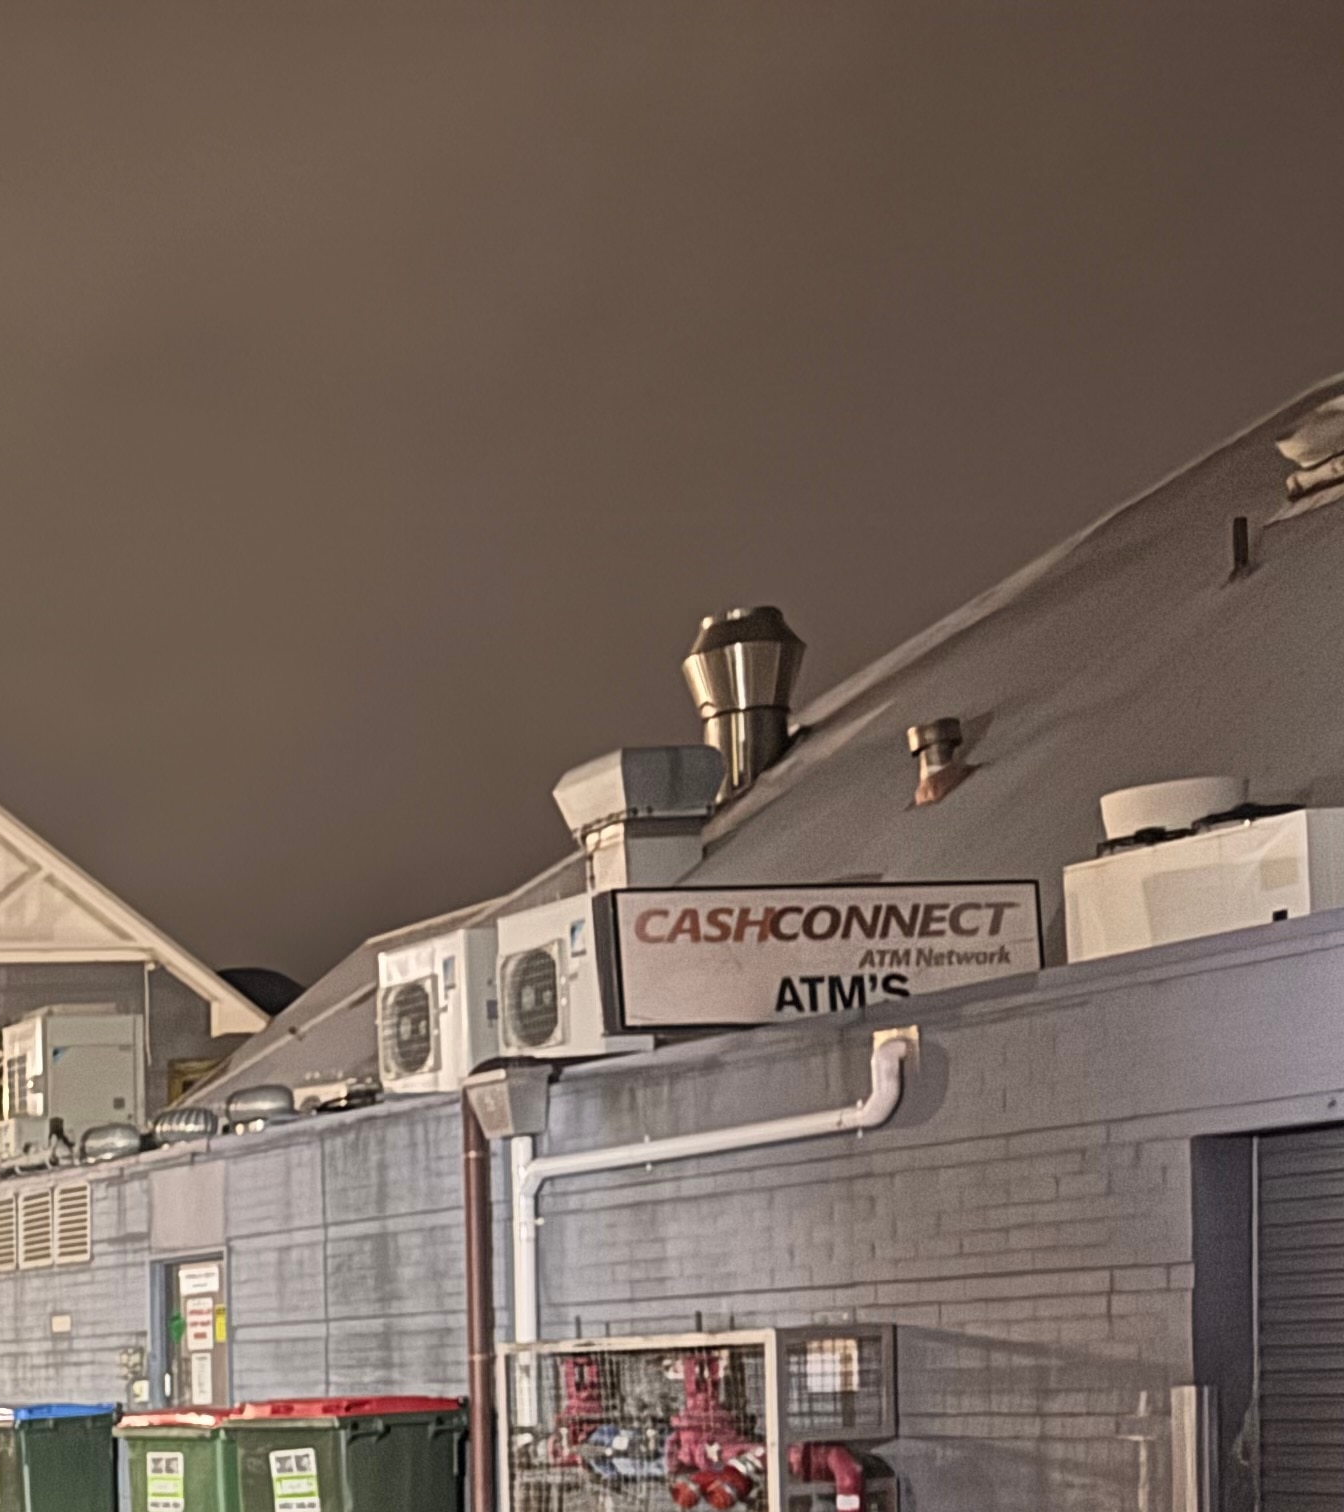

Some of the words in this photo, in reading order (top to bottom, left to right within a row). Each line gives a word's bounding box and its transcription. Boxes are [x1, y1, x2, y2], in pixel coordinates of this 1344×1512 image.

[634, 901, 1021, 944] CASHCONNECT
[859, 947, 913, 969] ATM
[915, 945, 1012, 968] Network
